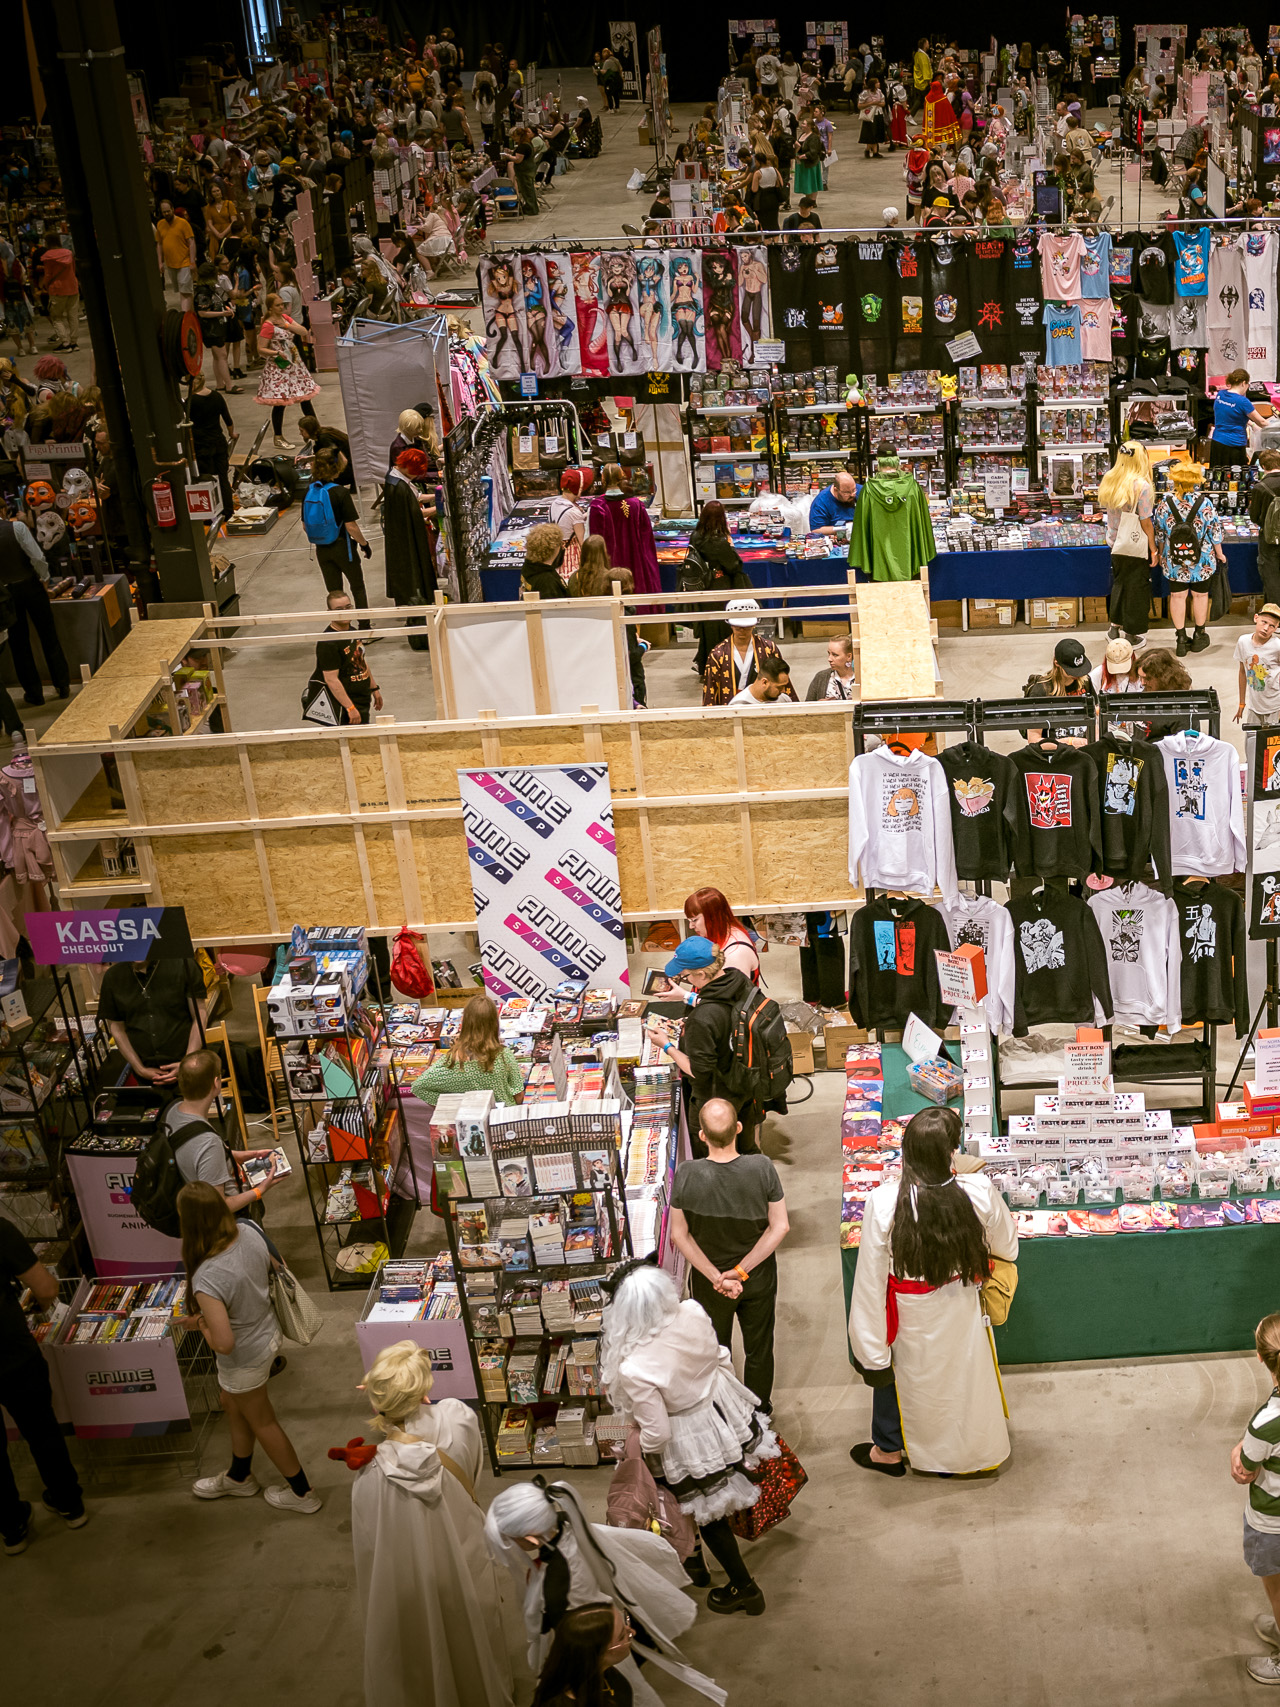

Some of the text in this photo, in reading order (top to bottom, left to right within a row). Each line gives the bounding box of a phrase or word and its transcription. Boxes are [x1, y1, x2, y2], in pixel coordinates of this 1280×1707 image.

[859, 248, 884, 260] WAY
[1050, 318, 1072, 330] GAME
[1052, 328, 1075, 338] OVER
[553, 876, 621, 932] SHOP
[1185, 905, 1199, 920] 五
[56, 918, 162, 943] KASSA
[517, 895, 606, 972] ANIME
[61, 944, 124, 954] CHECKOUT
[513, 921, 580, 977] SHOP
[944, 990, 962, 998] PRICE:
[86, 1368, 154, 1384] ANIME
